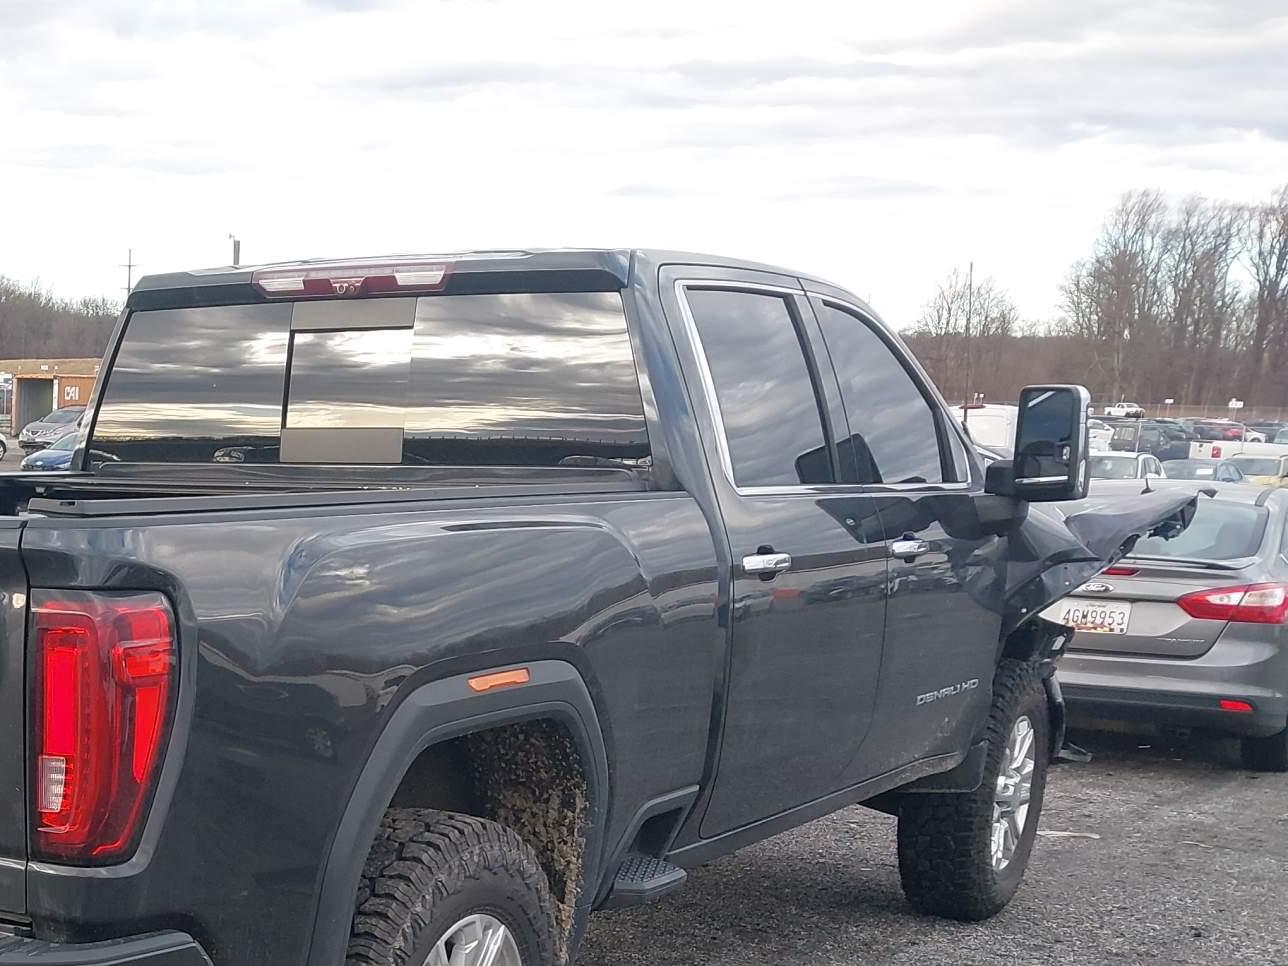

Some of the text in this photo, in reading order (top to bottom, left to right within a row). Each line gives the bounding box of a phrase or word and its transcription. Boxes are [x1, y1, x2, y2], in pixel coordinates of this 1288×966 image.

[1063, 608, 1126, 626] 4GM9953
[916, 679, 979, 705] DENALI HD
